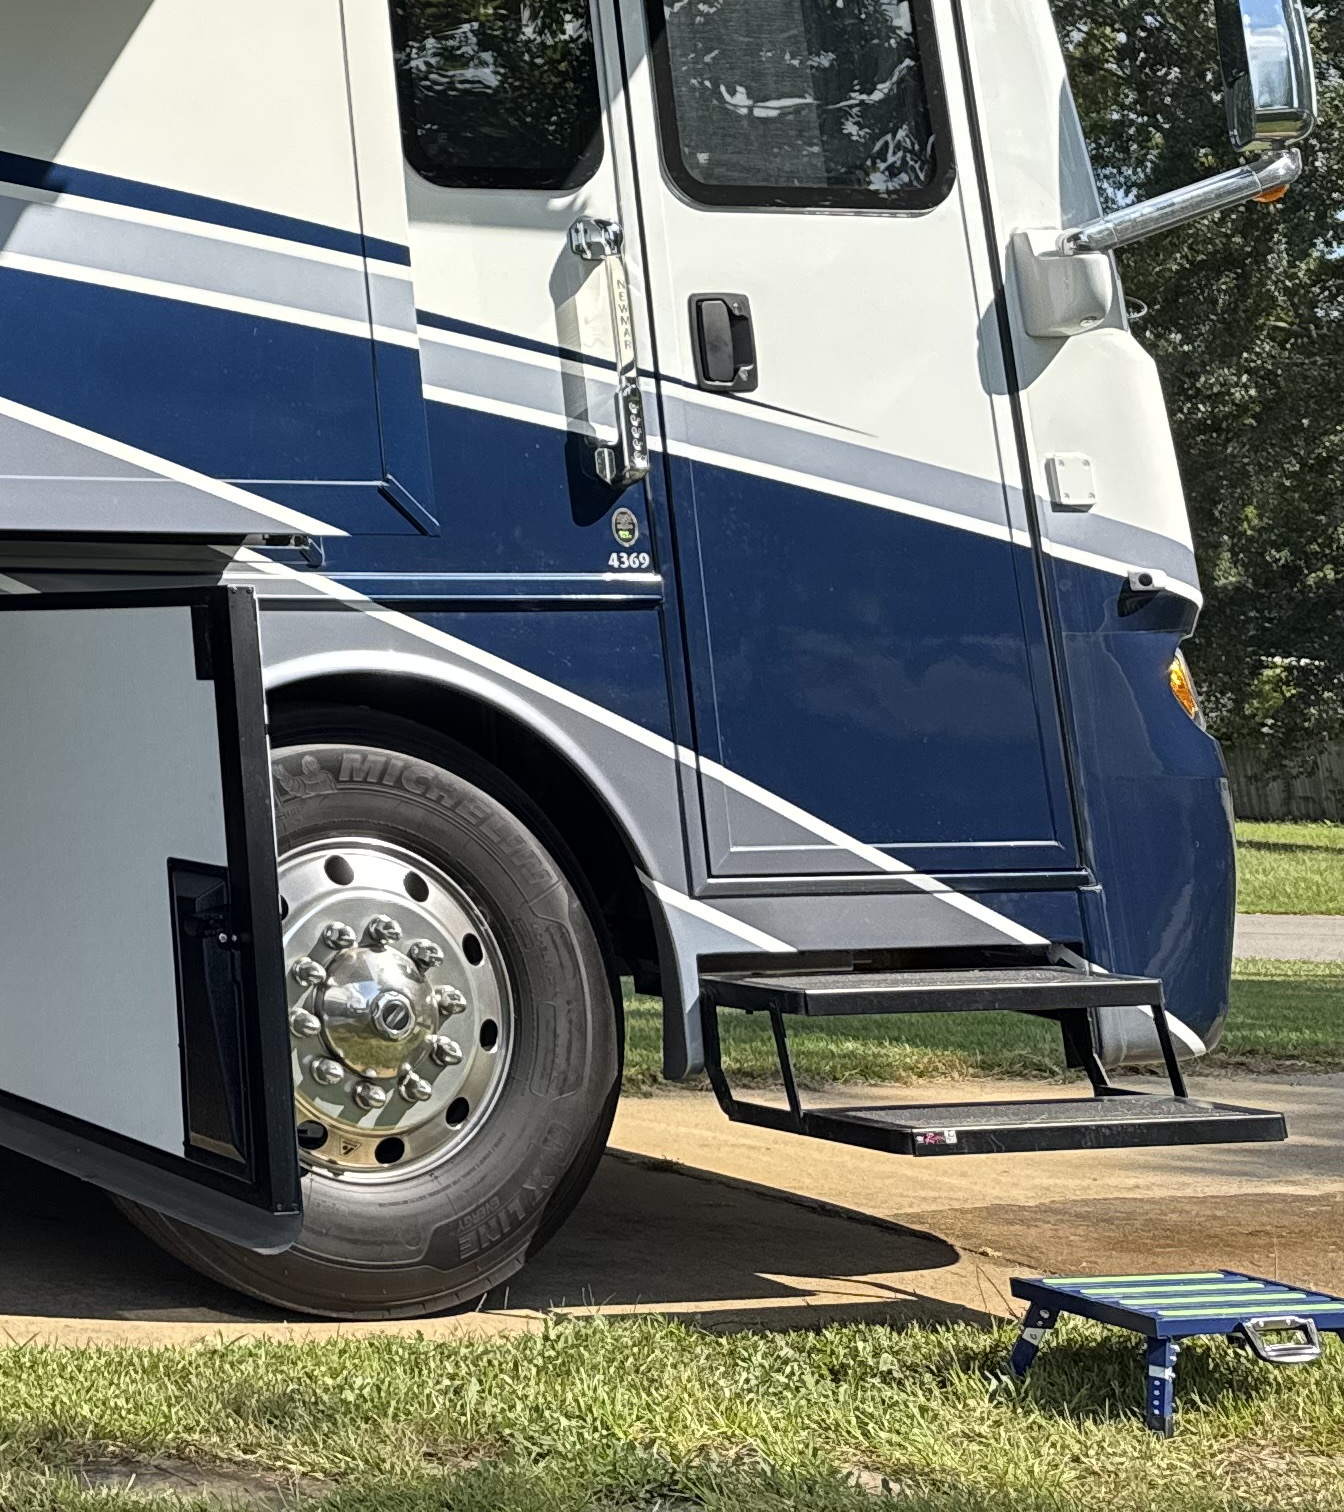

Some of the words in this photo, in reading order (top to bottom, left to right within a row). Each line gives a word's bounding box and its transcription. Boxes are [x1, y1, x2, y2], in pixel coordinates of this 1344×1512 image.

[616, 279, 632, 350] NEWMAR
[607, 551, 650, 569] 4369
[339, 751, 559, 884] MICHELIN
[459, 1197, 526, 1259] LINE
